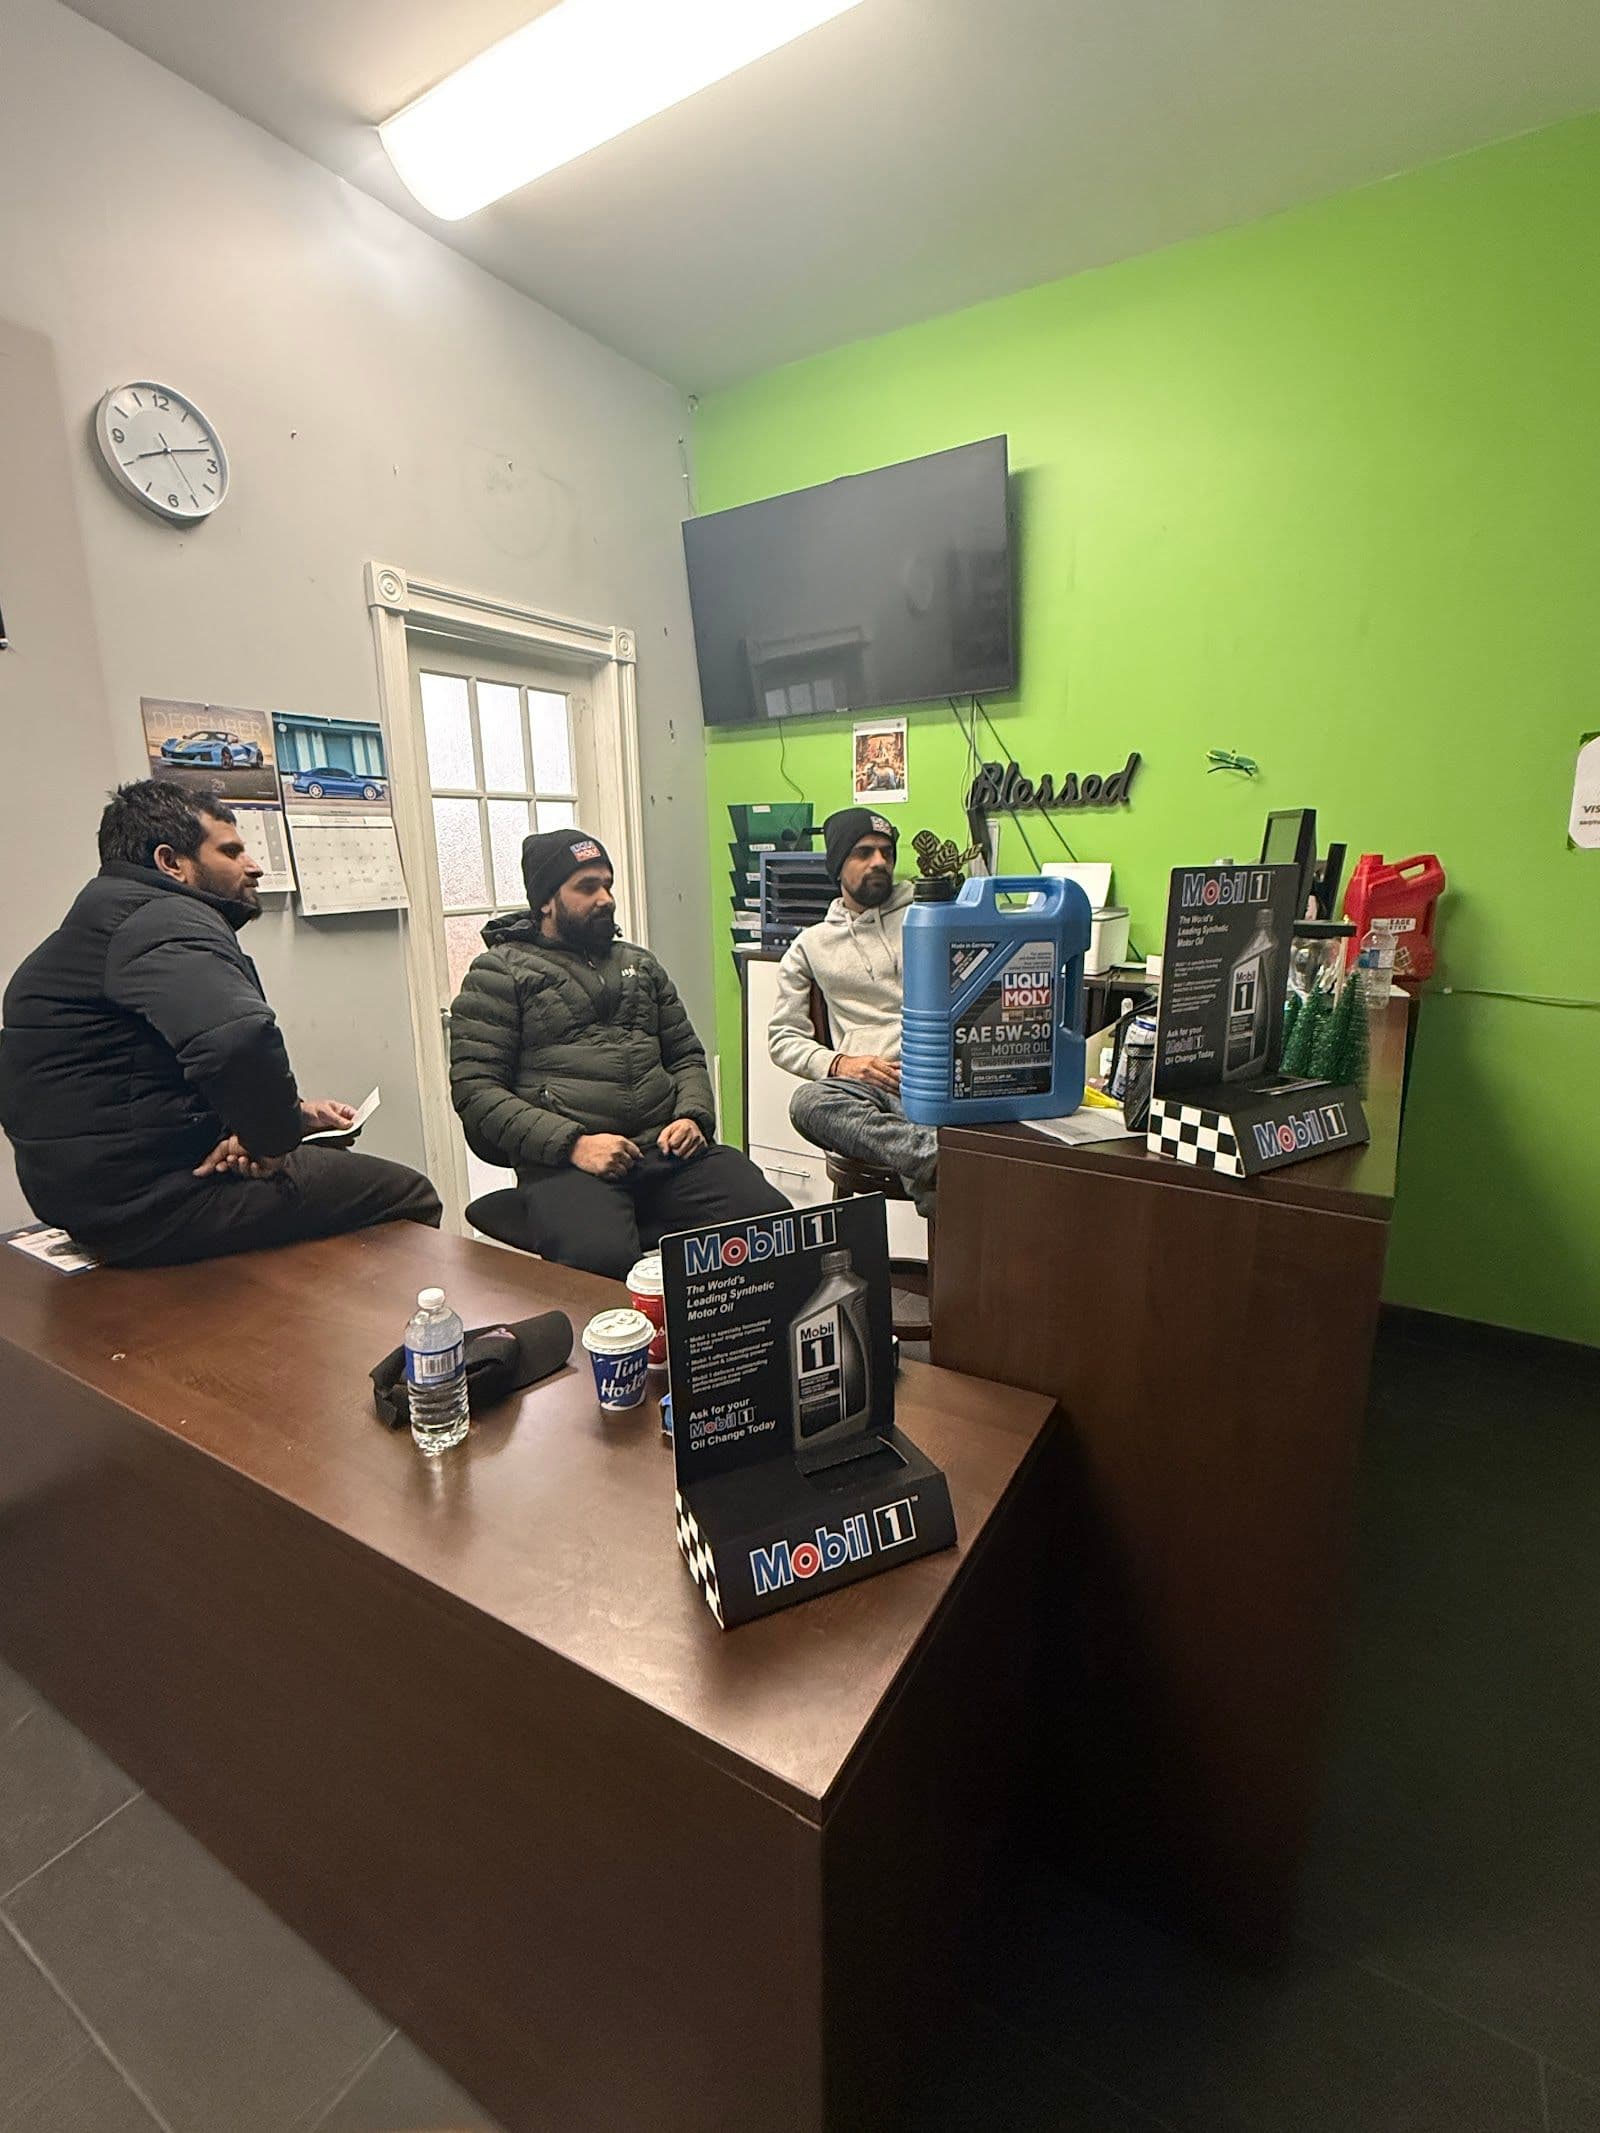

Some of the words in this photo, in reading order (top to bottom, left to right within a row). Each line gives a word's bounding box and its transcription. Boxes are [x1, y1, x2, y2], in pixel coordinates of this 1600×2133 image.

[152, 394, 169, 411] 12
[112, 428, 125, 443] 9
[207, 459, 218, 474] 3
[168, 494, 179, 507] 6
[152, 711, 262, 736] DECEMBER
[967, 752, 1141, 810] Blessed
[1182, 872, 1248, 907] Mobil
[1004, 972, 1049, 989] LIQUI
[1236, 971, 1256, 981] Mobil
[1005, 989, 1050, 1007] MOLY
[955, 1026, 992, 1044] SAE
[995, 1022, 1051, 1042] 5W-30
[991, 1042, 1031, 1056] MOTOR
[1032, 1041, 1050, 1053] OIL
[1252, 1109, 1324, 1160] Mobil
[684, 1218, 795, 1276] Mobil
[686, 1284, 705, 1296] The
[707, 1275, 745, 1291] World's
[687, 1291, 727, 1309] Leading
[729, 1280, 775, 1299] Synthetic
[688, 1307, 717, 1321] Motor
[720, 1302, 734, 1314] Oil
[800, 1321, 834, 1340] Mobil
[610, 1356, 642, 1379] Tim
[600, 1371, 647, 1398] Horto
[689, 1408, 709, 1421] Ask
[711, 1404, 725, 1415] for
[727, 1398, 750, 1412] your
[689, 1412, 736, 1439] Mobil
[691, 1440, 705, 1451] Oil
[707, 1429, 745, 1446] Change
[747, 1419, 776, 1434] Today
[749, 1513, 872, 1596] Mobil
